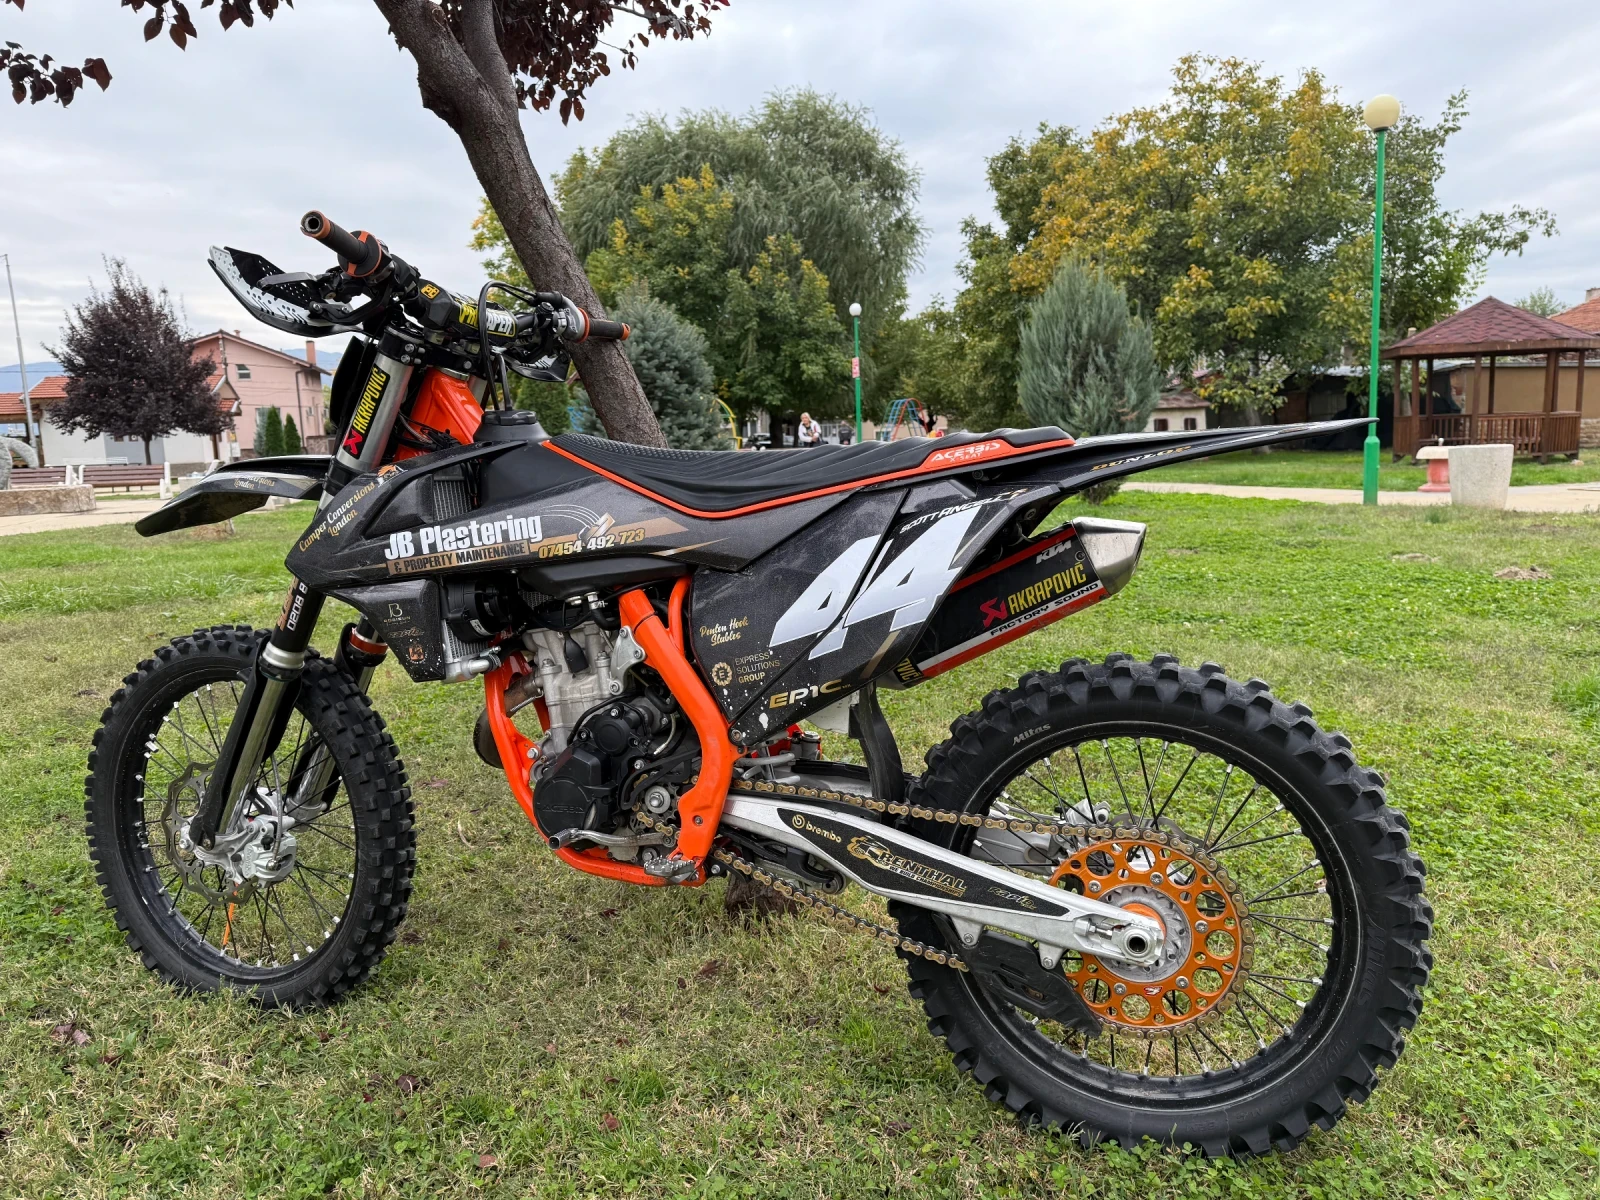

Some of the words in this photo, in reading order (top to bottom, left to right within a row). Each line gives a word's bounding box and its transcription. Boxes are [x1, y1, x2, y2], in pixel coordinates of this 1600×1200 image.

[931, 442, 1001, 462] ACERBIS
[299, 520, 327, 552] Camper
[327, 481, 376, 524] Conversions
[327, 509, 358, 537] London
[900, 511, 940, 534] SCOTT
[384, 530, 415, 560] JB
[419, 514, 543, 555] Plastering
[538, 541, 583, 559] 07454
[586, 535, 615, 550] 492
[619, 528, 646, 545] 723
[403, 553, 453, 572] PROPERTY
[456, 542, 526, 564] MAINTENANCE
[1035, 540, 1072, 565] KTM
[769, 505, 982, 660] 44
[286, 594, 304, 632] 0208
[990, 605, 1049, 636] FACTORY
[1054, 583, 1099, 607] SOUND
[729, 615, 749, 630] Hook
[710, 631, 741, 647] Stables
[734, 651, 770, 666] EXPRESS
[736, 659, 781, 674] SOLUTIONS
[738, 671, 766, 684] GROUP
[1012, 723, 1051, 747] Mitas
[806, 821, 842, 843] brembo
[878, 850, 967, 889] RENTHAL
